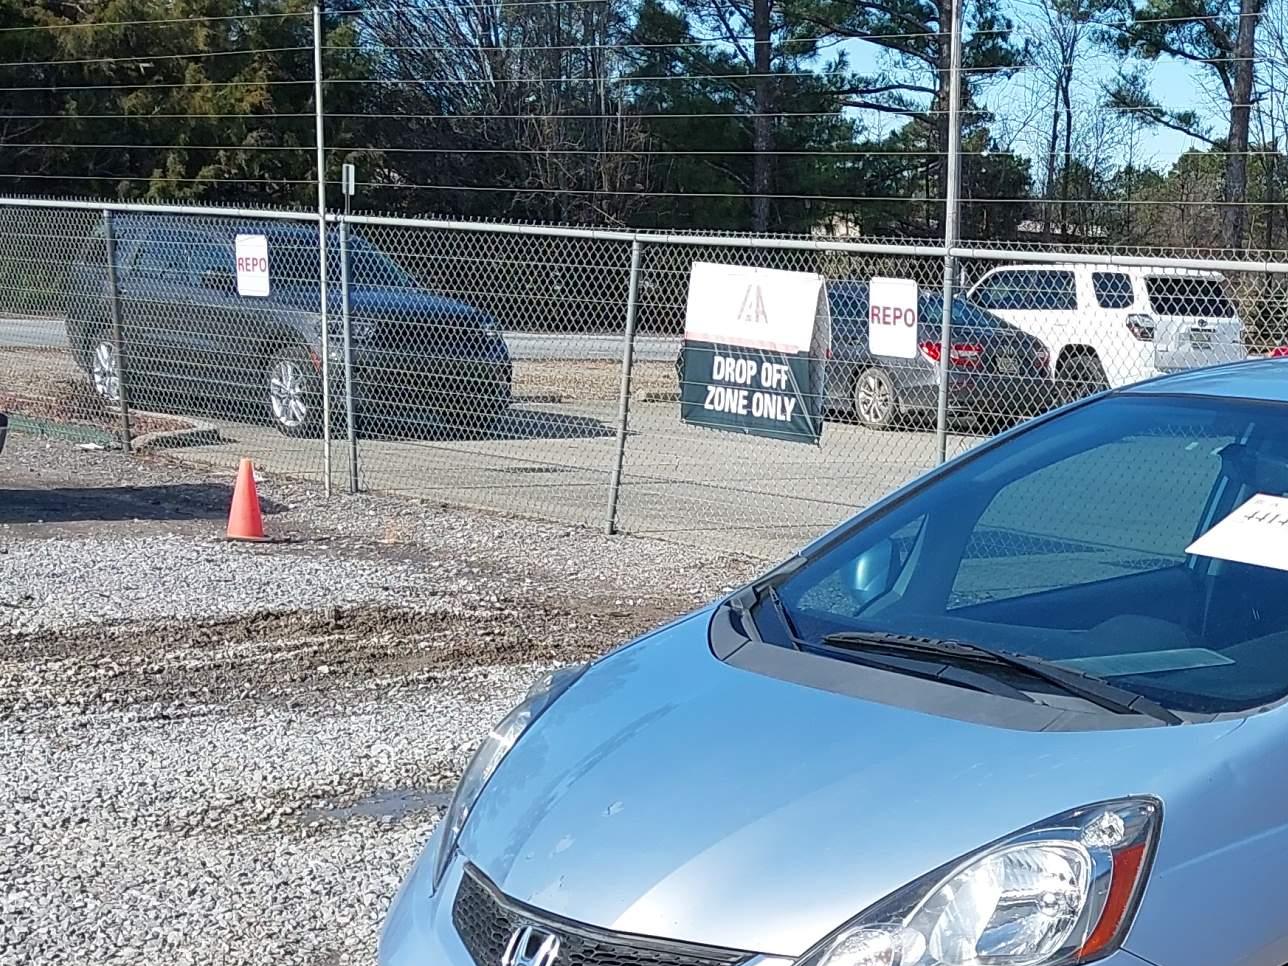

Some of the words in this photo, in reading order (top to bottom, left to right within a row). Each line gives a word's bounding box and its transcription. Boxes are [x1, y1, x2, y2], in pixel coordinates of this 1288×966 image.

[237, 257, 267, 273] REPO
[871, 305, 916, 328] REPO
[712, 355, 757, 385] DROP
[761, 362, 789, 390] OFF
[704, 385, 748, 415] ZONE
[752, 392, 796, 422] ONLY
